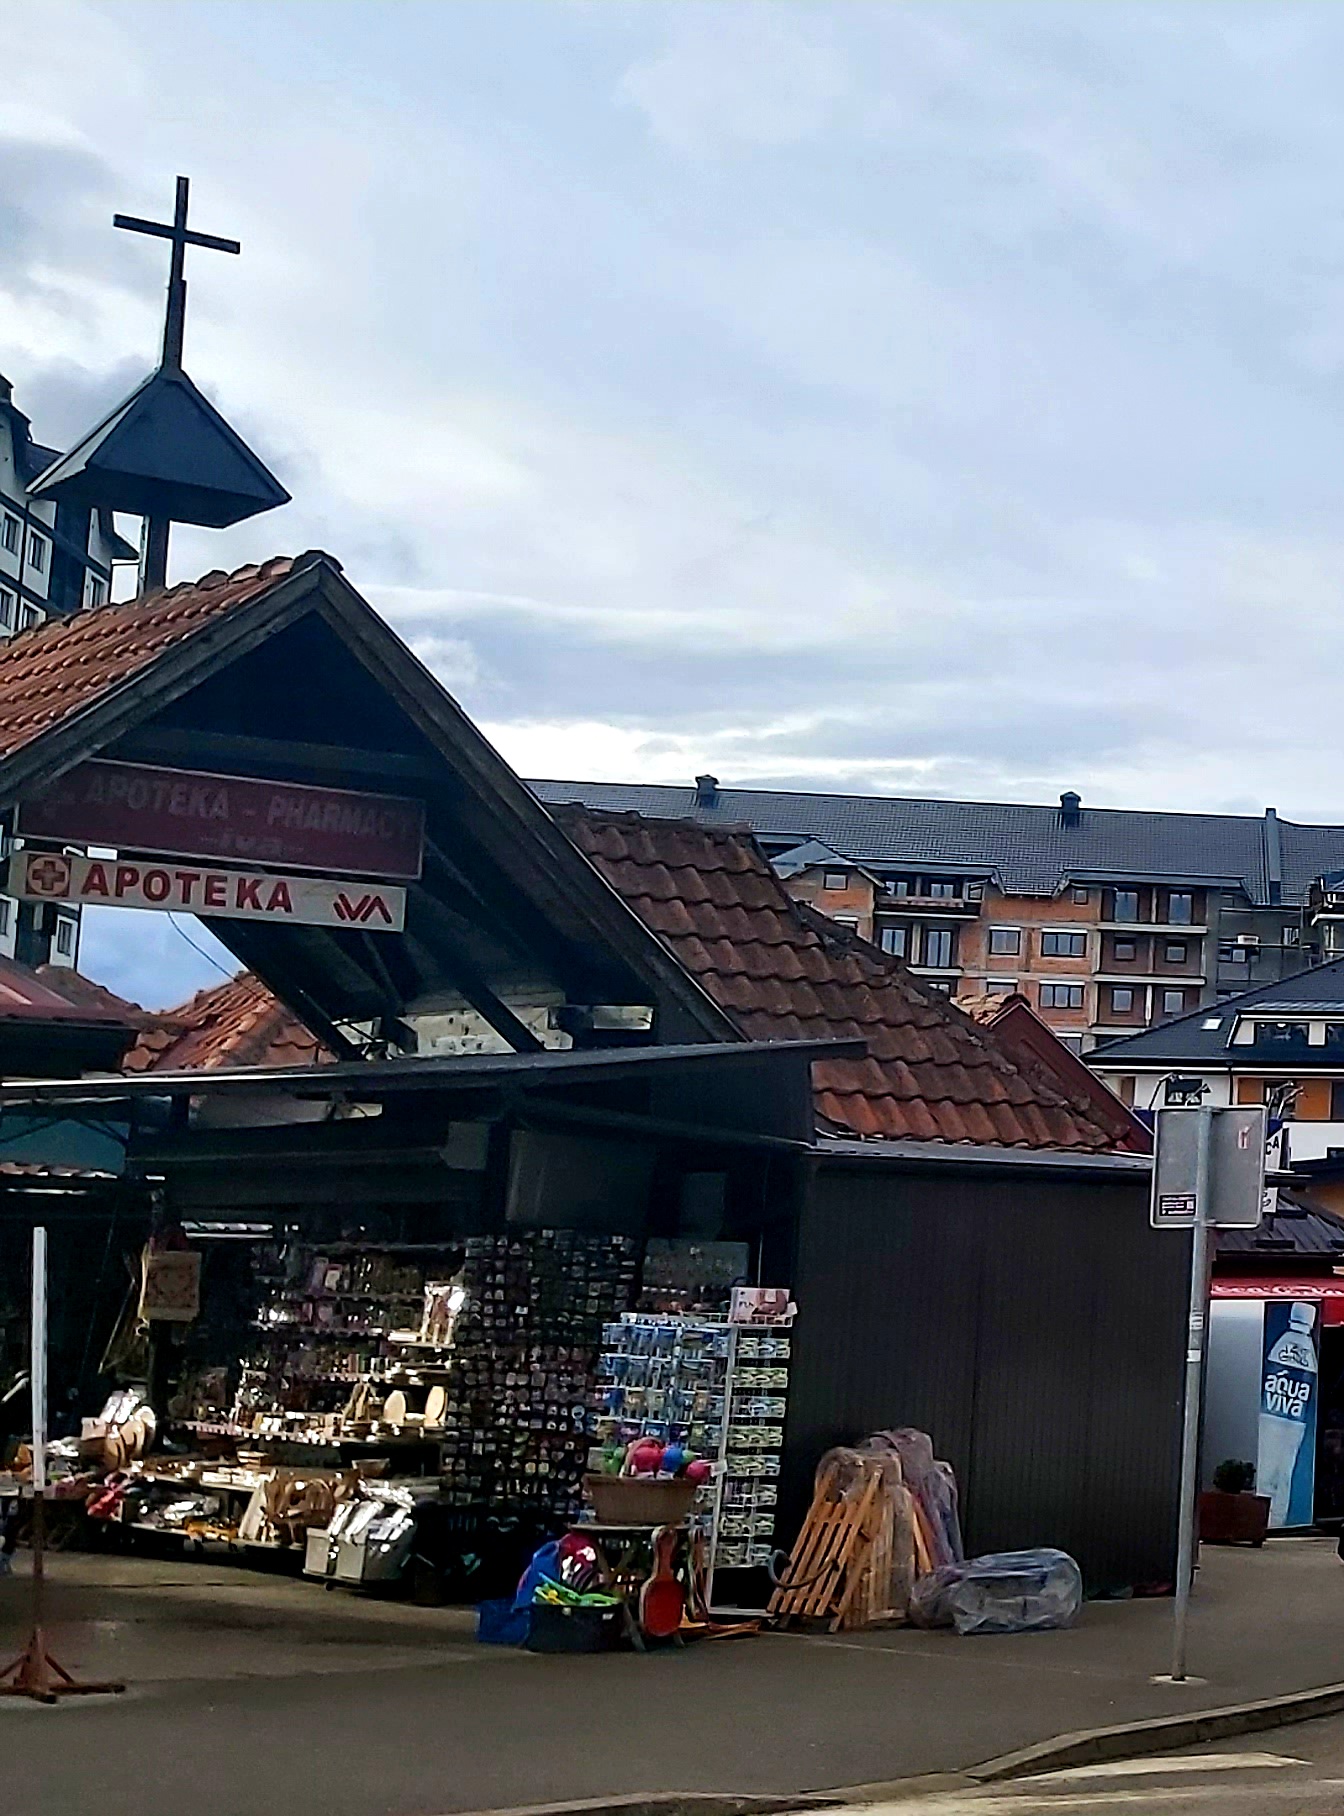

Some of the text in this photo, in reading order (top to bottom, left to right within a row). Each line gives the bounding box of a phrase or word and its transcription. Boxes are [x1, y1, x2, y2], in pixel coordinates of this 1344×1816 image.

[86, 775, 230, 820] APOTEKA
[81, 863, 293, 914] APOTEKA
[1265, 1391, 1304, 1418] viva
